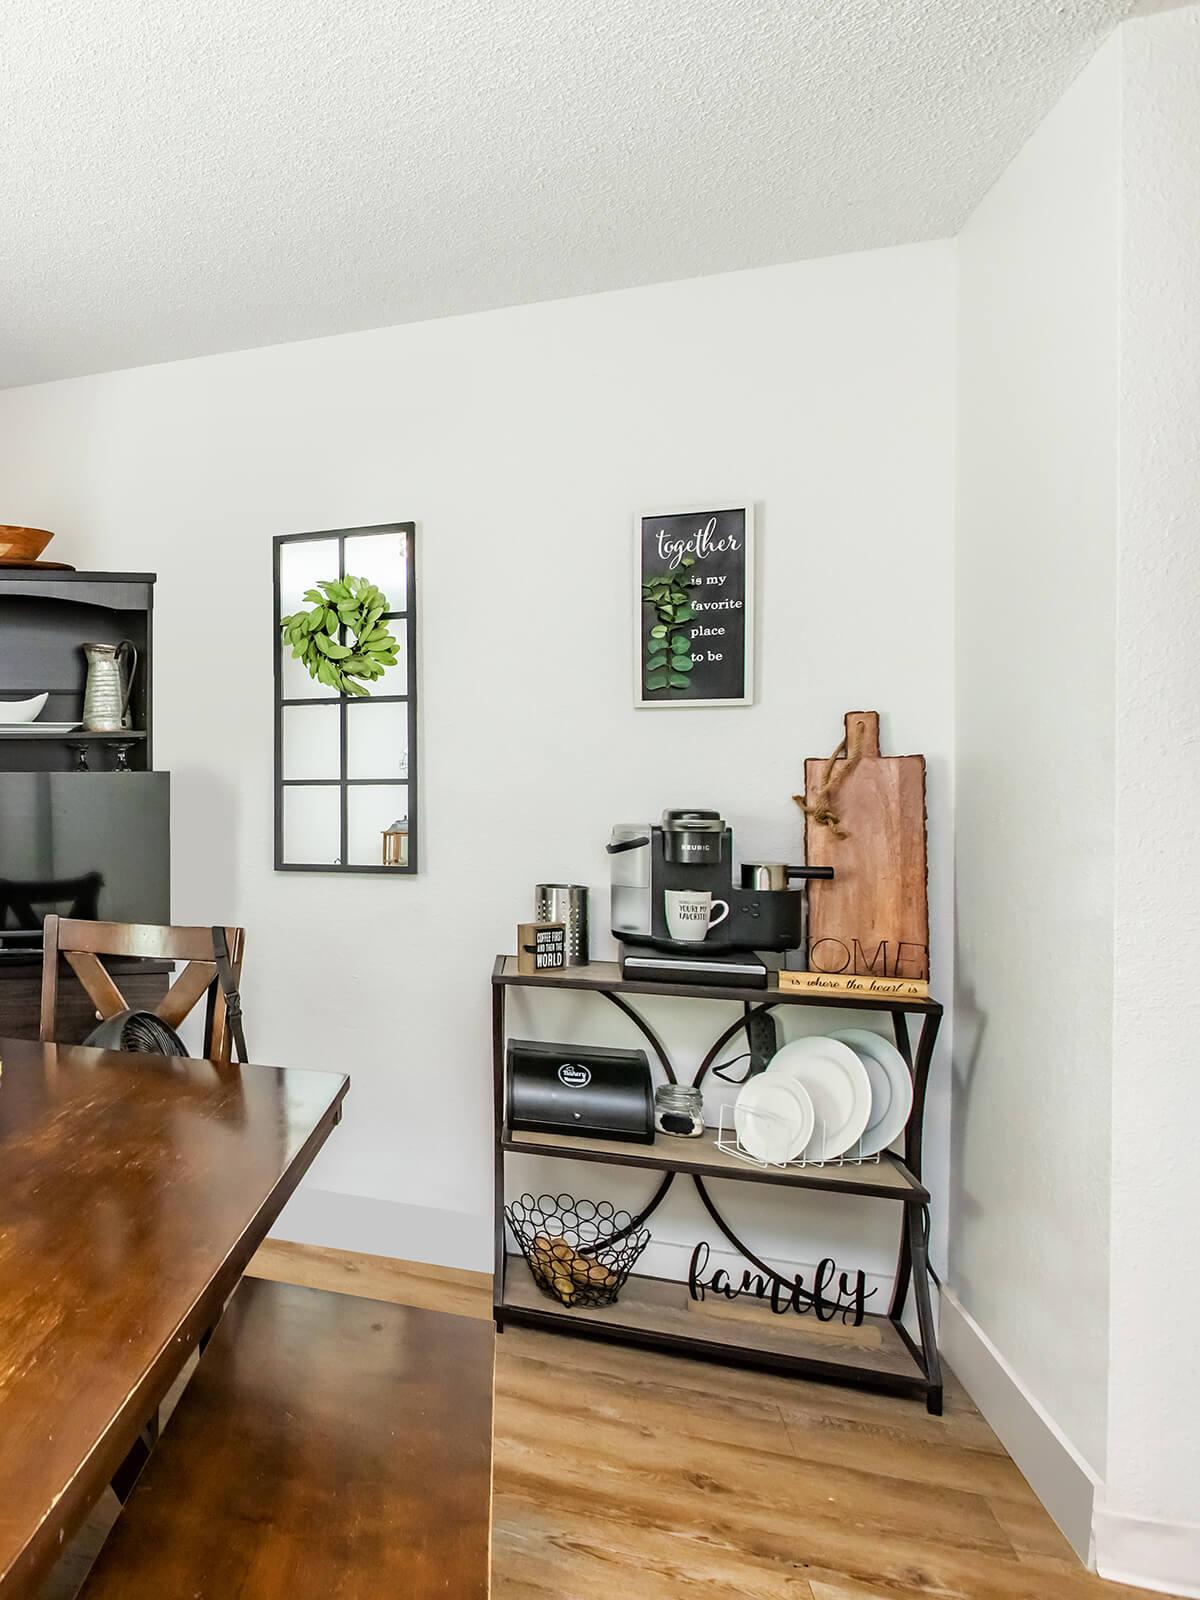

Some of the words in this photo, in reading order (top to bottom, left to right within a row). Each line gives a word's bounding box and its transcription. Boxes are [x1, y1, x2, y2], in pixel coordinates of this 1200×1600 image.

[655, 517, 741, 570] together
[690, 575, 702, 586] is
[706, 575, 727, 586] my
[690, 598, 743, 611] favorite
[690, 625, 726, 639] place
[690, 652, 704, 662] to
[707, 650, 723, 662] be
[536, 931, 552, 944] COFFEE
[551, 930, 563, 942] FIRST
[536, 943, 546, 953] AND
[545, 943, 555, 952] THEN
[555, 942, 563, 951] THE
[536, 952, 563, 968] WORLD
[791, 976, 801, 986] is
[806, 976, 840, 989] where
[846, 978, 863, 990] the
[869, 980, 905, 993] heart
[907, 983, 918, 994] is
[688, 1241, 878, 1327] family
